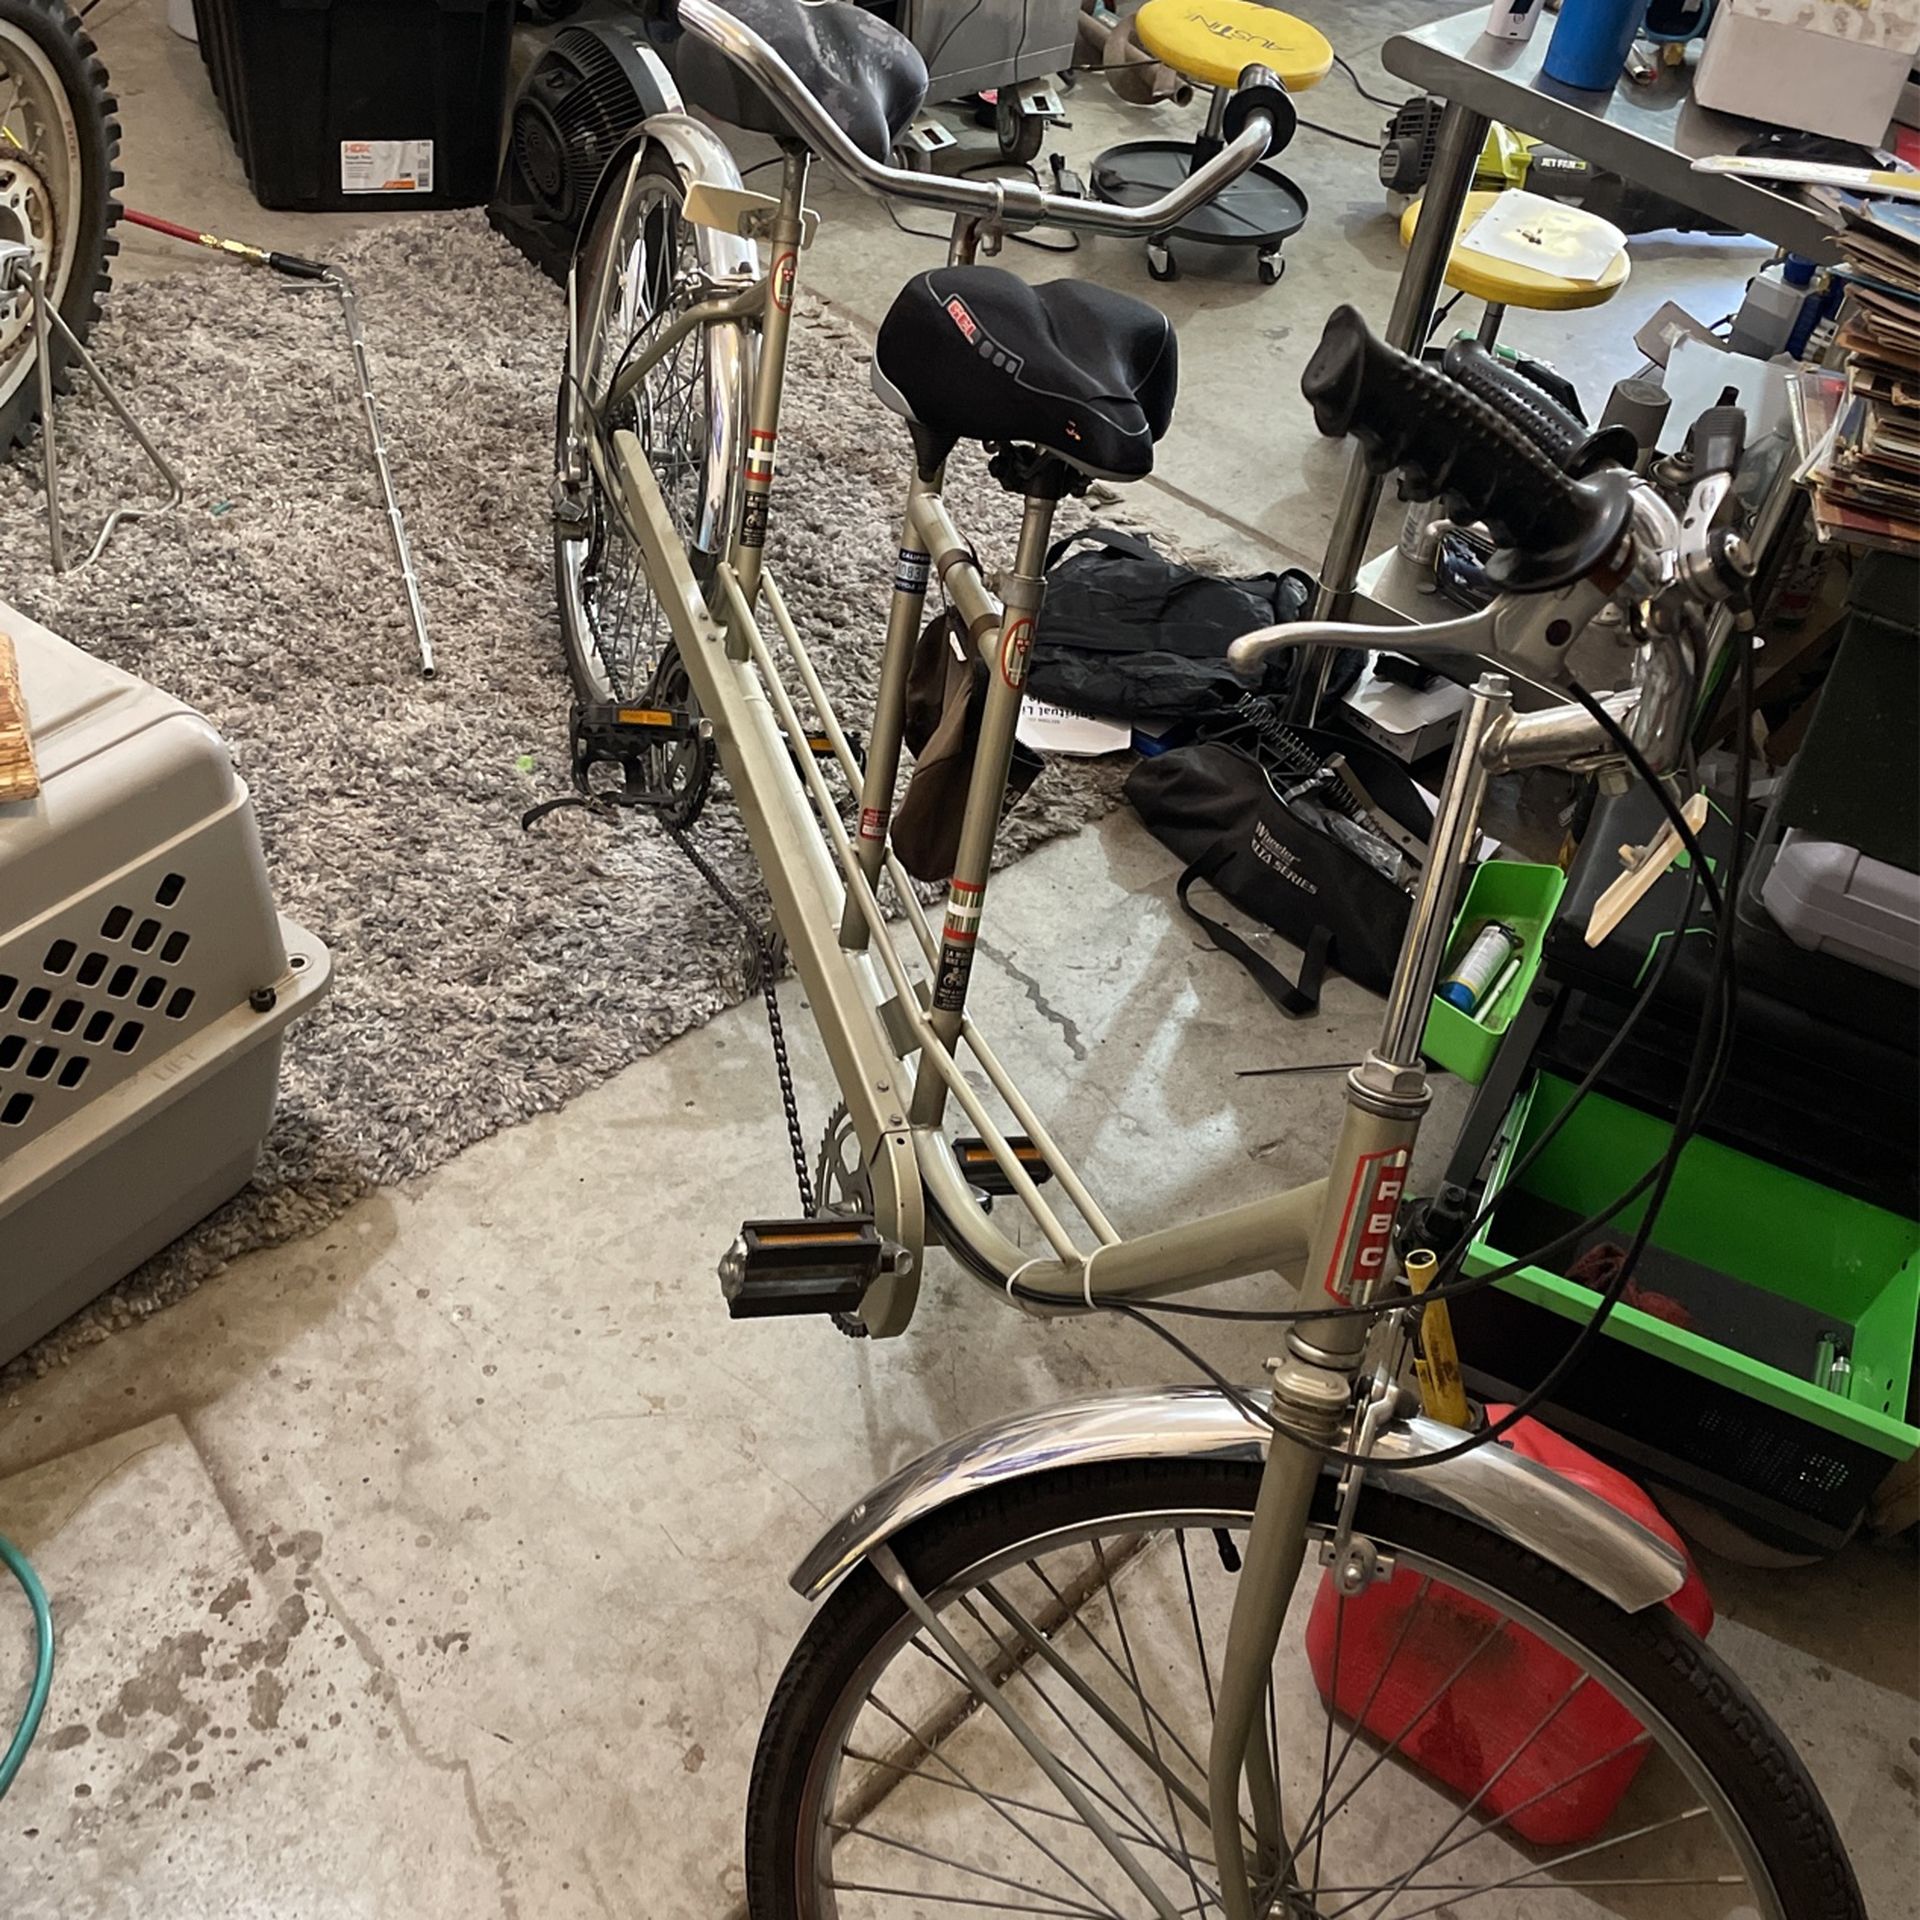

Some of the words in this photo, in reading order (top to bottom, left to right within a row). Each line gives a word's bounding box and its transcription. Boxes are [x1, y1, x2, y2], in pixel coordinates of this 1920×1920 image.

[1190, 13, 1295, 52] AUSTIN
[1541, 157, 1556, 168] JET
[1255, 820, 1296, 863] Wheeler
[1273, 860, 1319, 895] SERIES
[152, 1053, 196, 1081] LIFT
[1360, 1181, 1401, 1267] ABC
